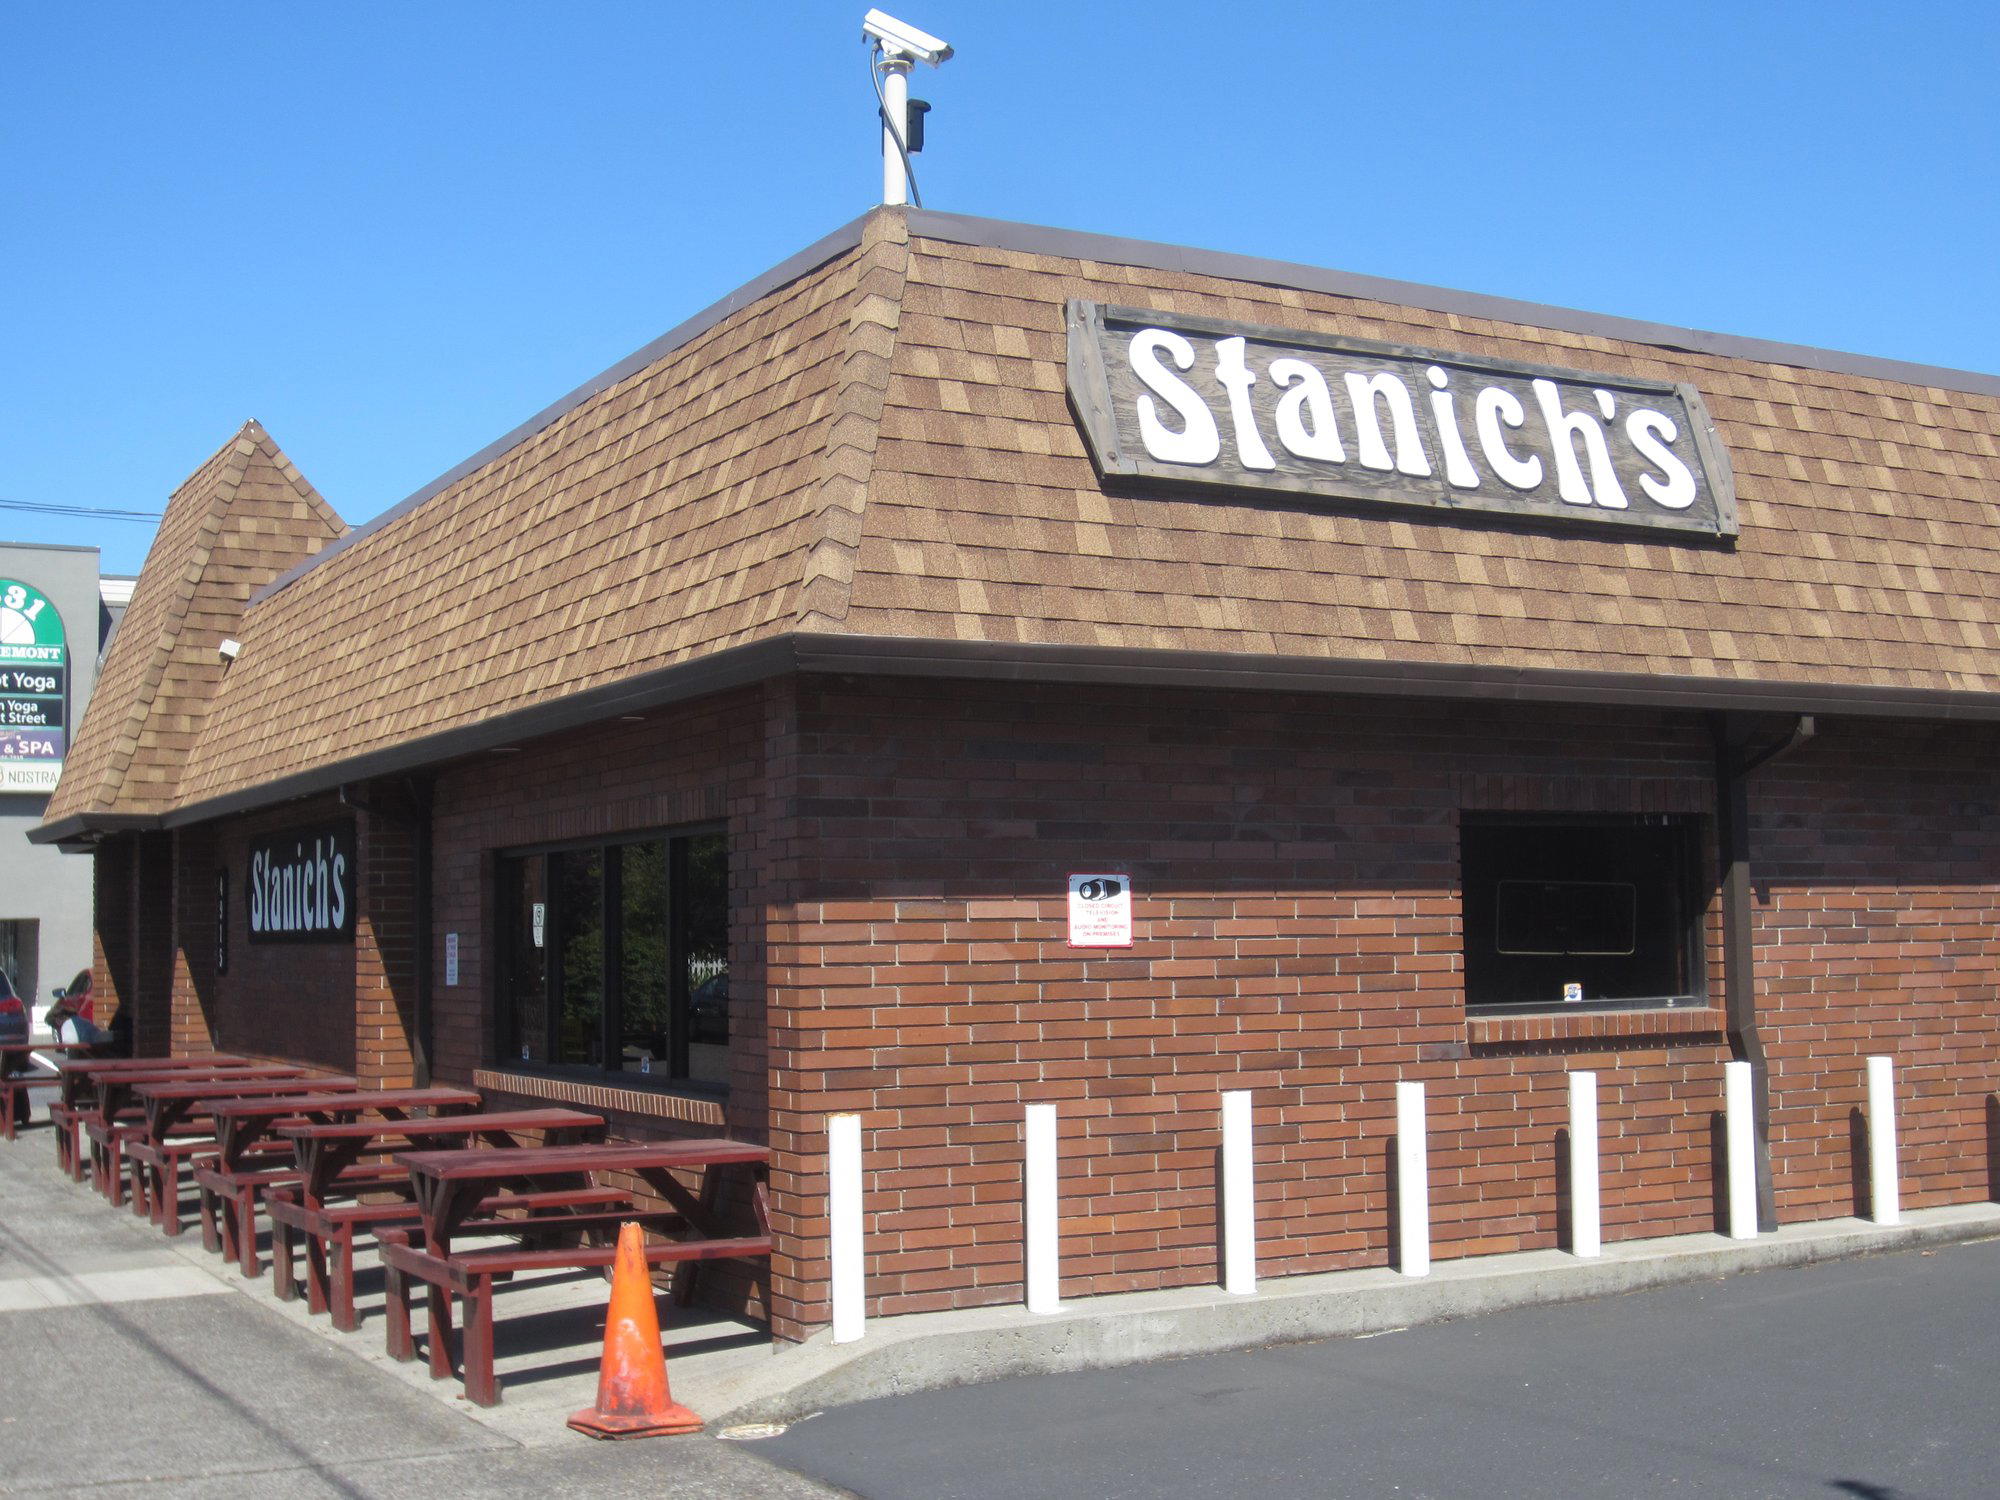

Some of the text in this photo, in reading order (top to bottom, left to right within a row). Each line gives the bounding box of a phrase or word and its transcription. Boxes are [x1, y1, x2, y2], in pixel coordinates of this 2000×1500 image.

[1129, 328, 1697, 510] Stanich's
[0, 585, 46, 621] 31
[13, 672, 56, 692] Yoga
[7, 699, 38, 714] Yoga
[8, 711, 47, 724] Street
[18, 740, 55, 755] SPA
[8, 770, 57, 783] NOSTRA
[252, 835, 345, 932] Stanich's
